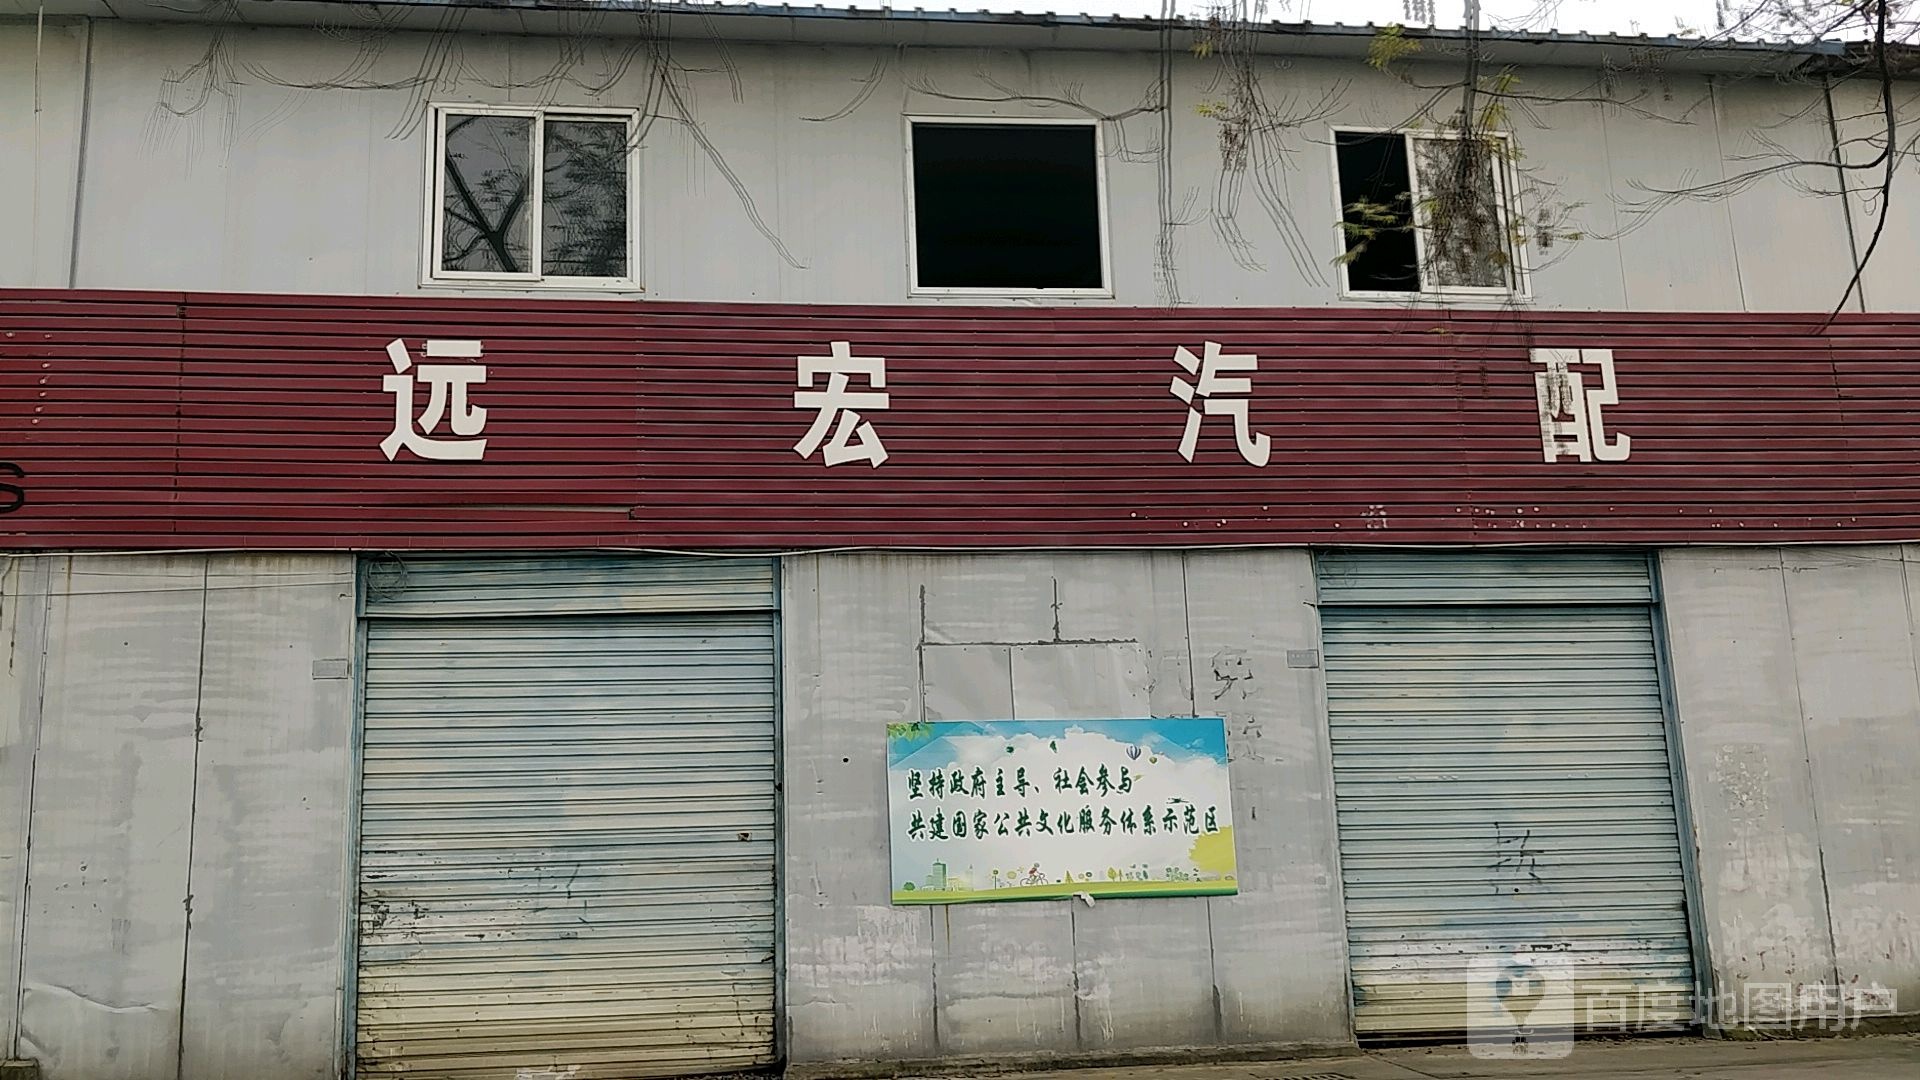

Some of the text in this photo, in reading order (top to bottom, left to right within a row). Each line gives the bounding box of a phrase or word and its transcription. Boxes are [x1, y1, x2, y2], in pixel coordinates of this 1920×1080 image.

[379, 338, 1631, 468] 远宏汽配
[907, 766, 1133, 799] 坚持政府主导、社会参与
[907, 804, 1220, 840] 共建国家公共文化服务体系示范区
